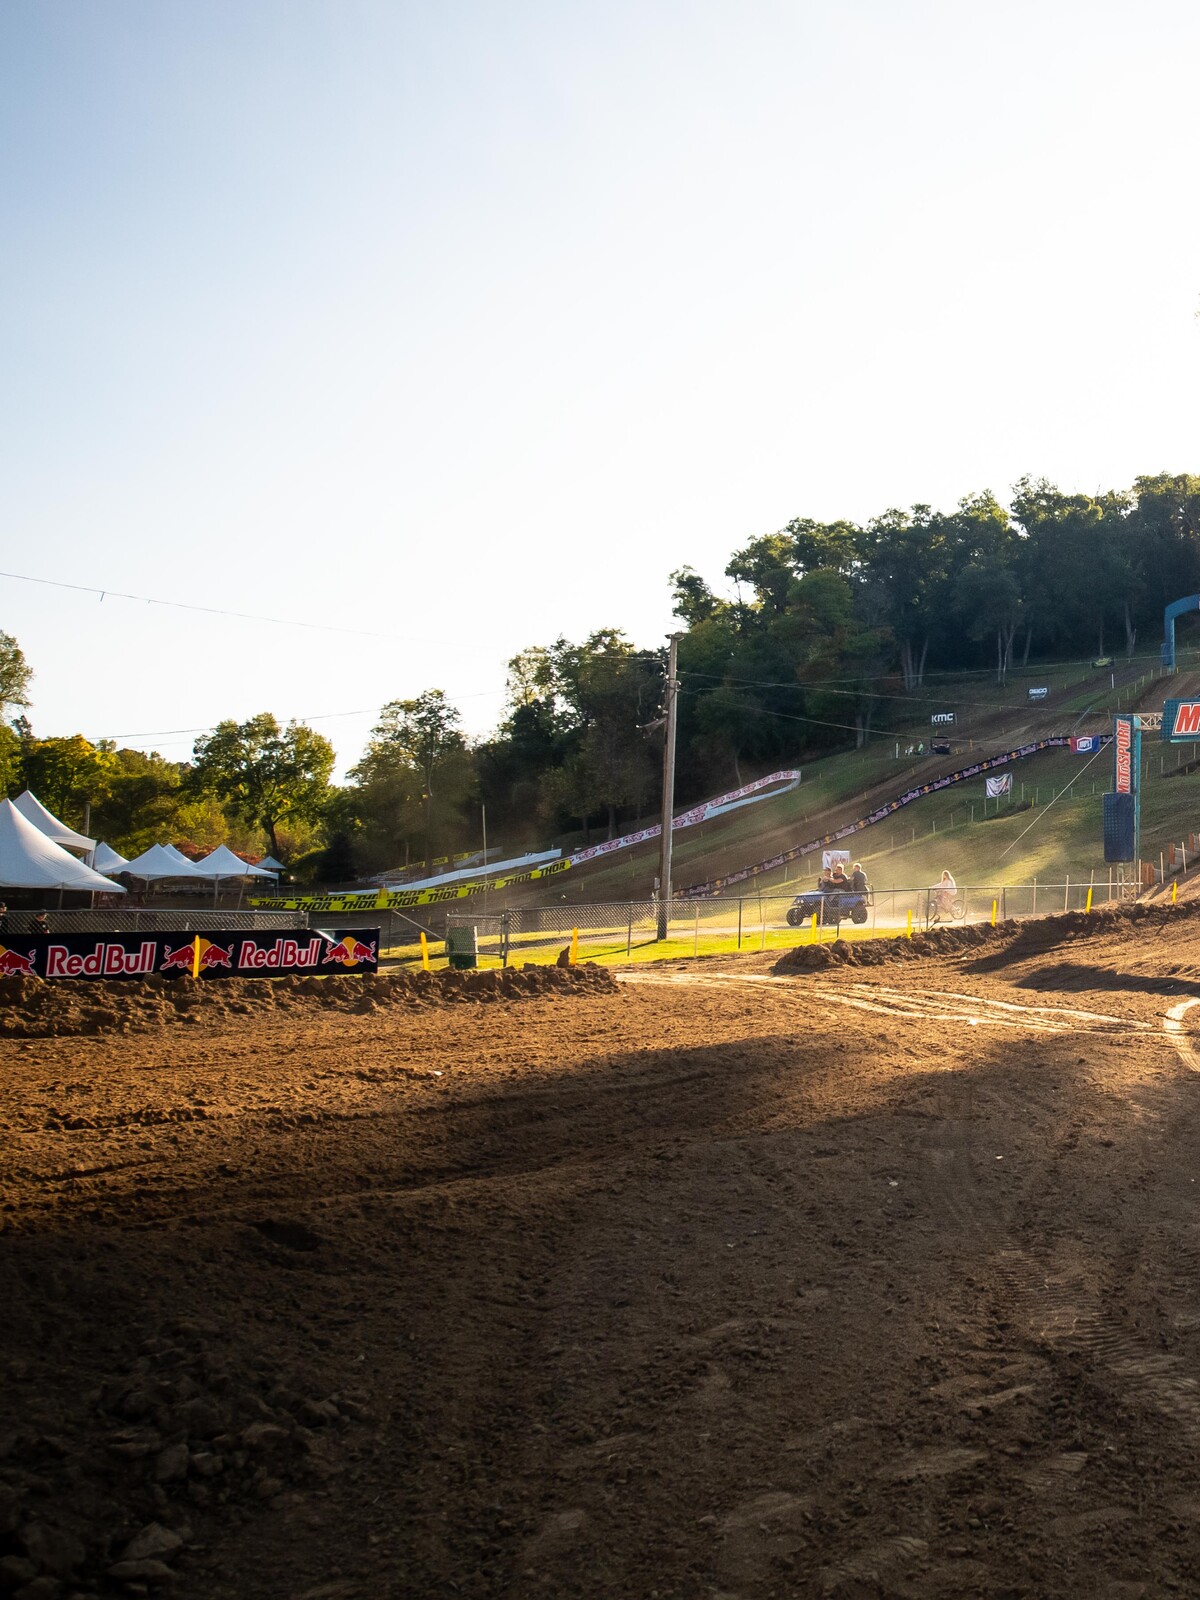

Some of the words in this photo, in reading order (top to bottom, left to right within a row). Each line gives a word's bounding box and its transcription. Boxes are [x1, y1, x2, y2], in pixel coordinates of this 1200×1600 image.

[931, 712, 954, 723] KMC
[540, 862, 566, 877] THOR
[466, 882, 497, 896] THOR
[428, 889, 459, 902] THOR
[295, 901, 332, 911] THOR
[342, 901, 376, 910] THOR
[387, 896, 419, 908] THOR
